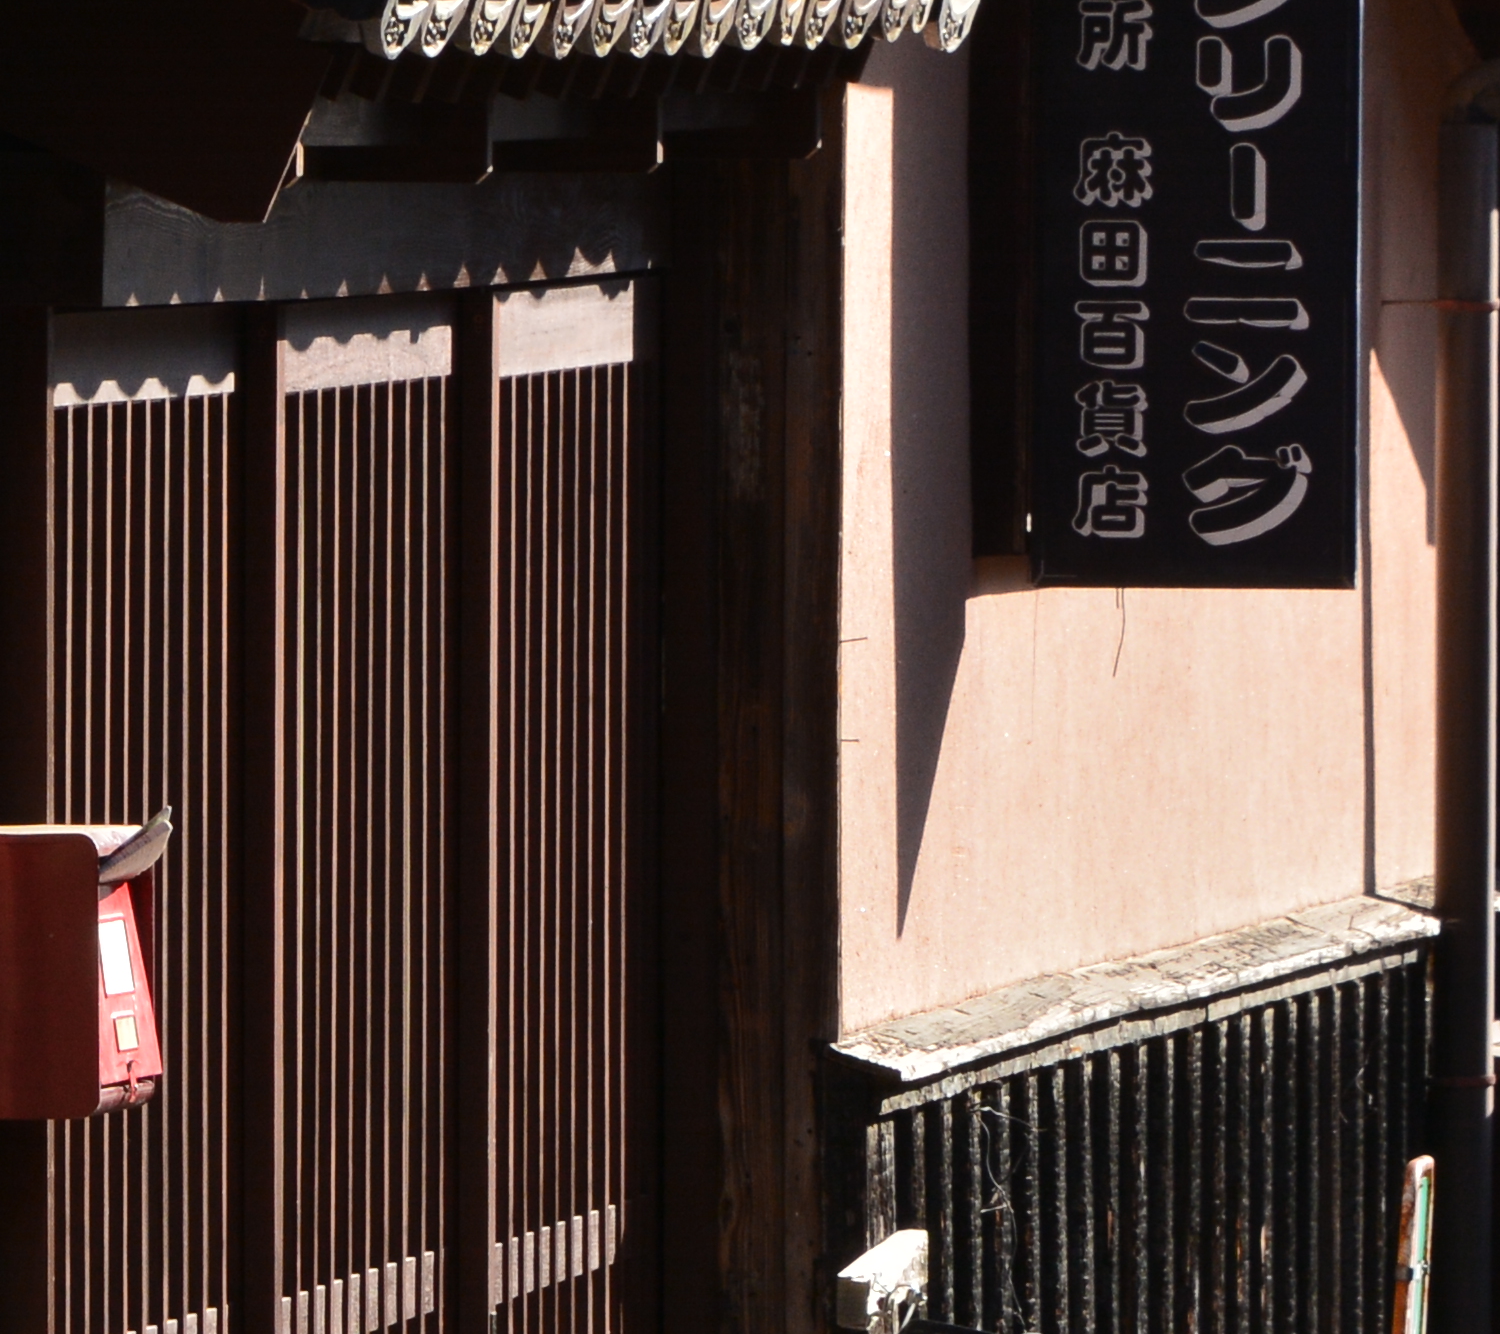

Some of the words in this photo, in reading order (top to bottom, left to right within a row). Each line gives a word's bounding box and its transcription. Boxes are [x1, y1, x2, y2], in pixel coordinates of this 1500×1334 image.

[1072, 130, 1153, 539] 麻田百貨店
